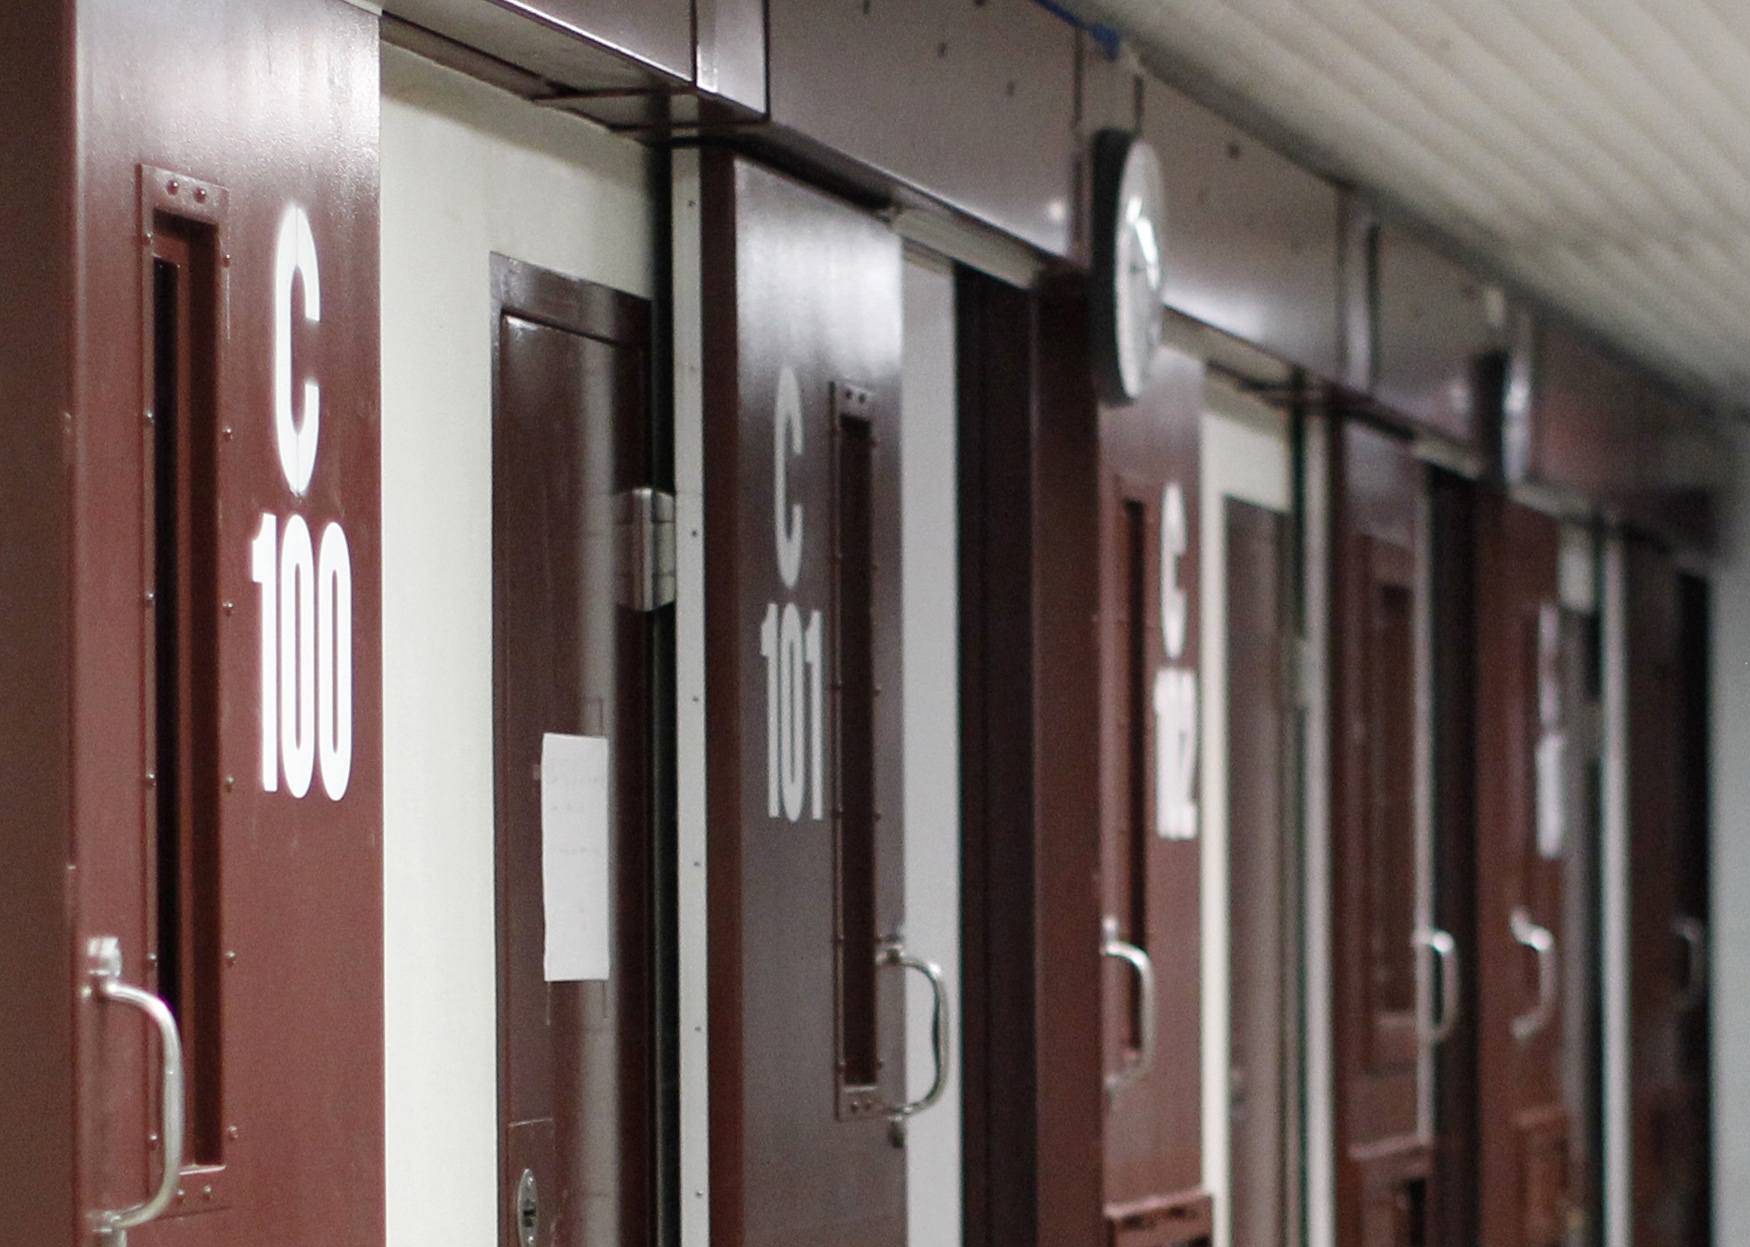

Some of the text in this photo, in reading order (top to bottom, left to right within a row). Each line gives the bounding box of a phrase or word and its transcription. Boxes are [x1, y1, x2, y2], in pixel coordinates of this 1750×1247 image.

[274, 203, 320, 498] C
[774, 366, 803, 589] C
[1160, 480, 1188, 659] C
[251, 511, 353, 801] 100
[760, 602, 824, 823] 101
